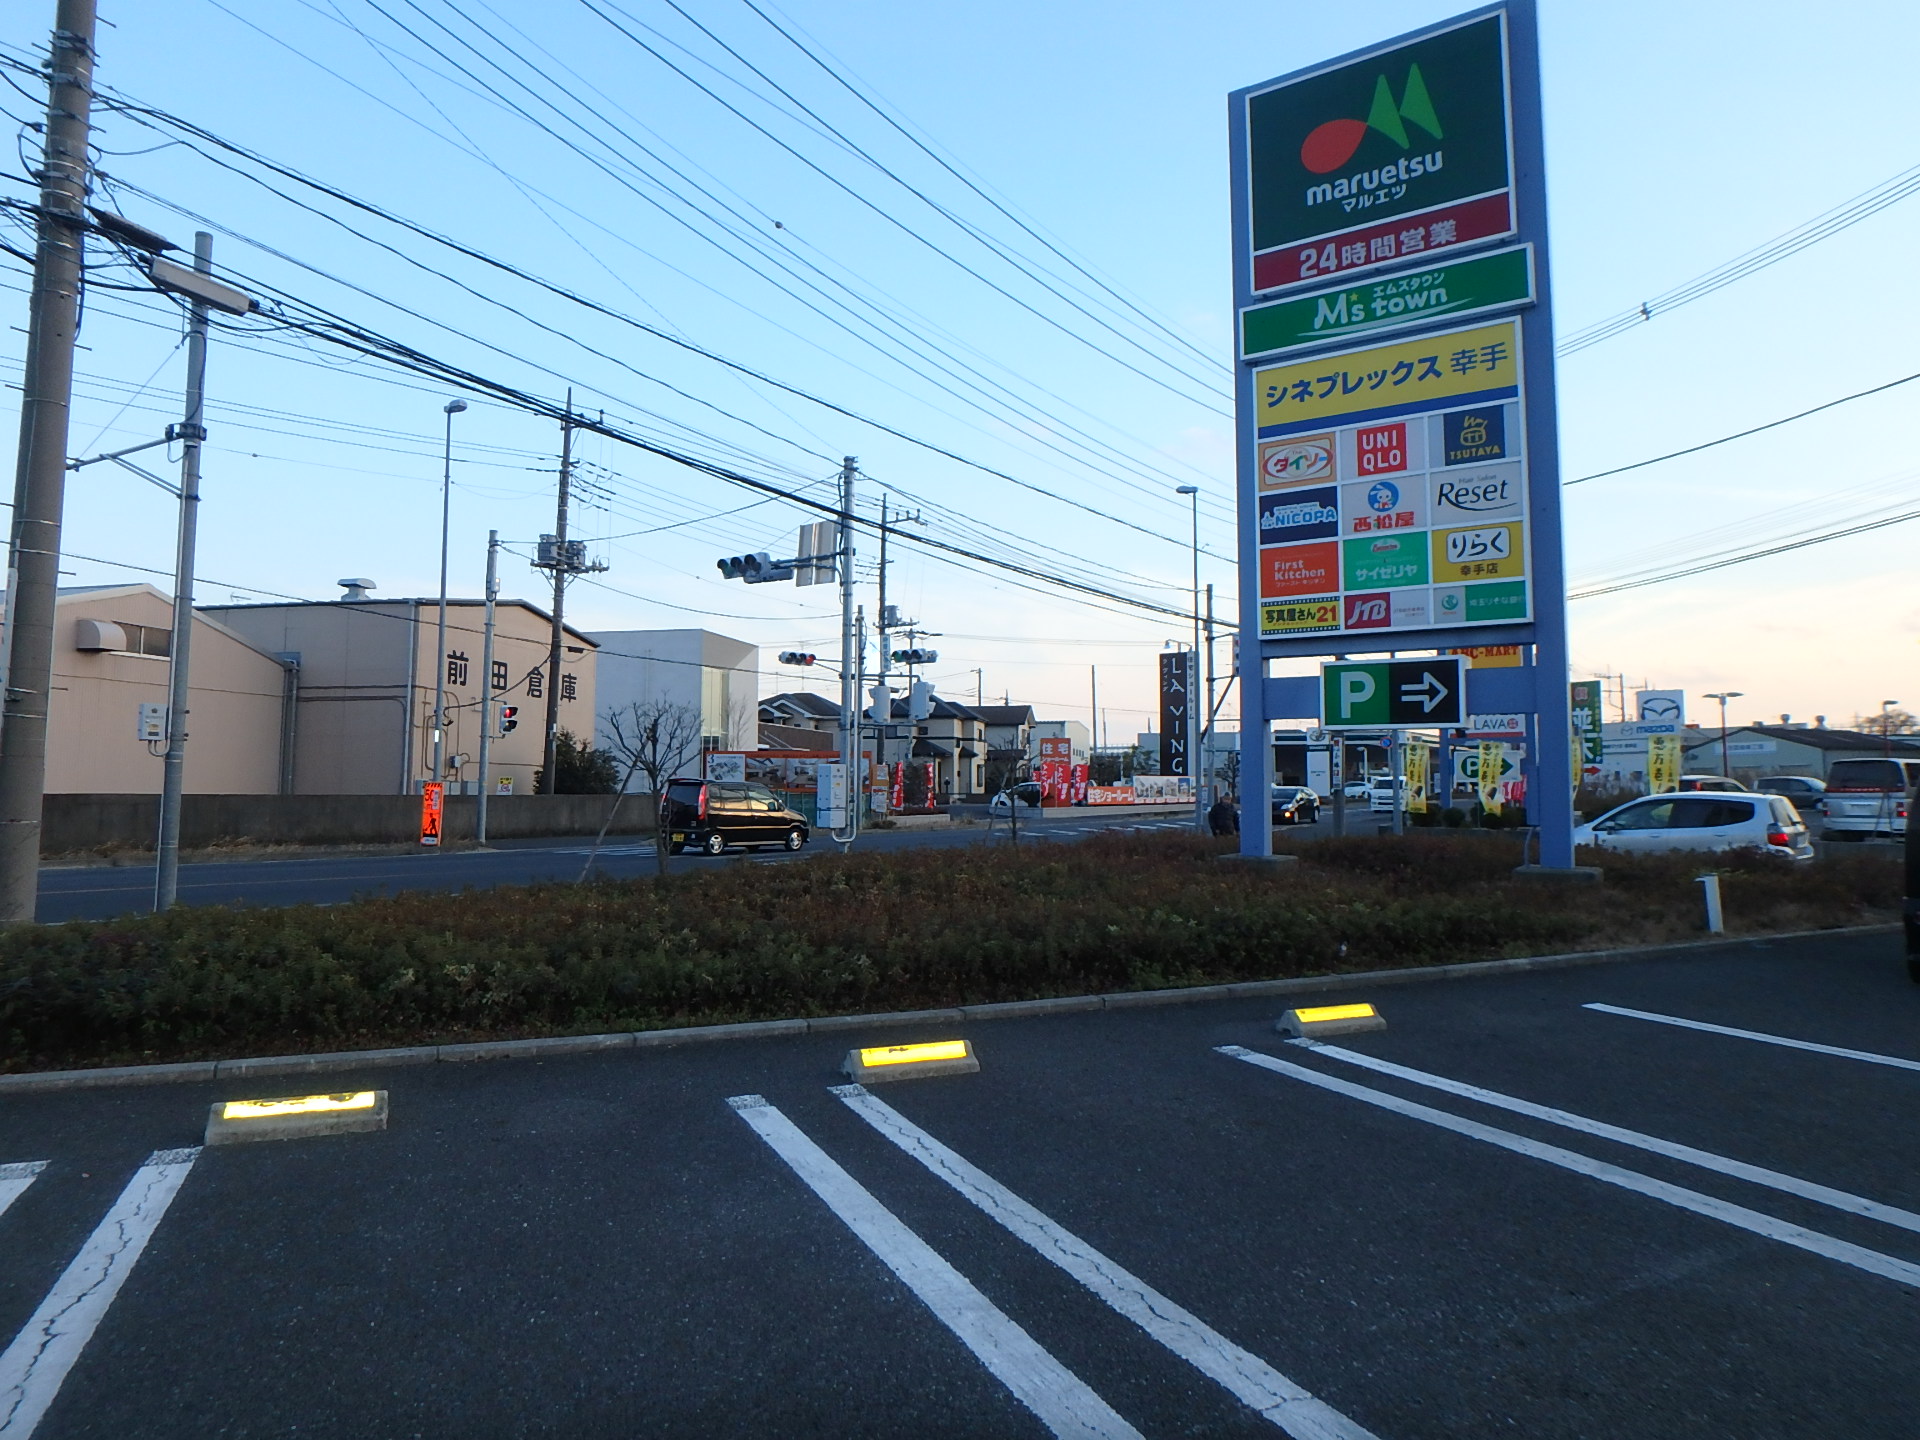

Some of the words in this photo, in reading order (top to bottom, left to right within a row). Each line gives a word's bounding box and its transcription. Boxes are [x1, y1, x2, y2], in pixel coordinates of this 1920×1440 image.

[1306, 150, 1443, 206] maruetsu
[1342, 183, 1407, 213] マルエツ
[1300, 218, 1457, 278] 24時間営業
[1371, 287, 1448, 317] town
[1266, 355, 1443, 408] シネプレックス
[1450, 341, 1509, 376] 幸手
[1362, 429, 1398, 450] UNI
[1274, 453, 1328, 474] ダイソー
[1363, 449, 1401, 472] QLO
[1450, 444, 1501, 460] TSUTAYA
[1437, 479, 1510, 507] Reset
[1275, 508, 1336, 526] NICOPA
[1353, 511, 1415, 533] 西松屋
[1452, 531, 1504, 559] りらく
[1274, 560, 1304, 571] First
[1274, 568, 1326, 581] Kitchen
[1355, 564, 1418, 582] サイゼリヤ
[1460, 563, 1498, 576] 幸手店
[1347, 600, 1387, 626] JTB
[447, 650, 578, 703] 前田倉庫
[1170, 658, 1185, 693] LA
[1340, 671, 1376, 719] P
[1474, 718, 1507, 730] LAVA
[1636, 724, 1675, 734] mazda
[1169, 705, 1185, 774] VING
[1087, 787, 1134, 802] 住宅ショールーム
